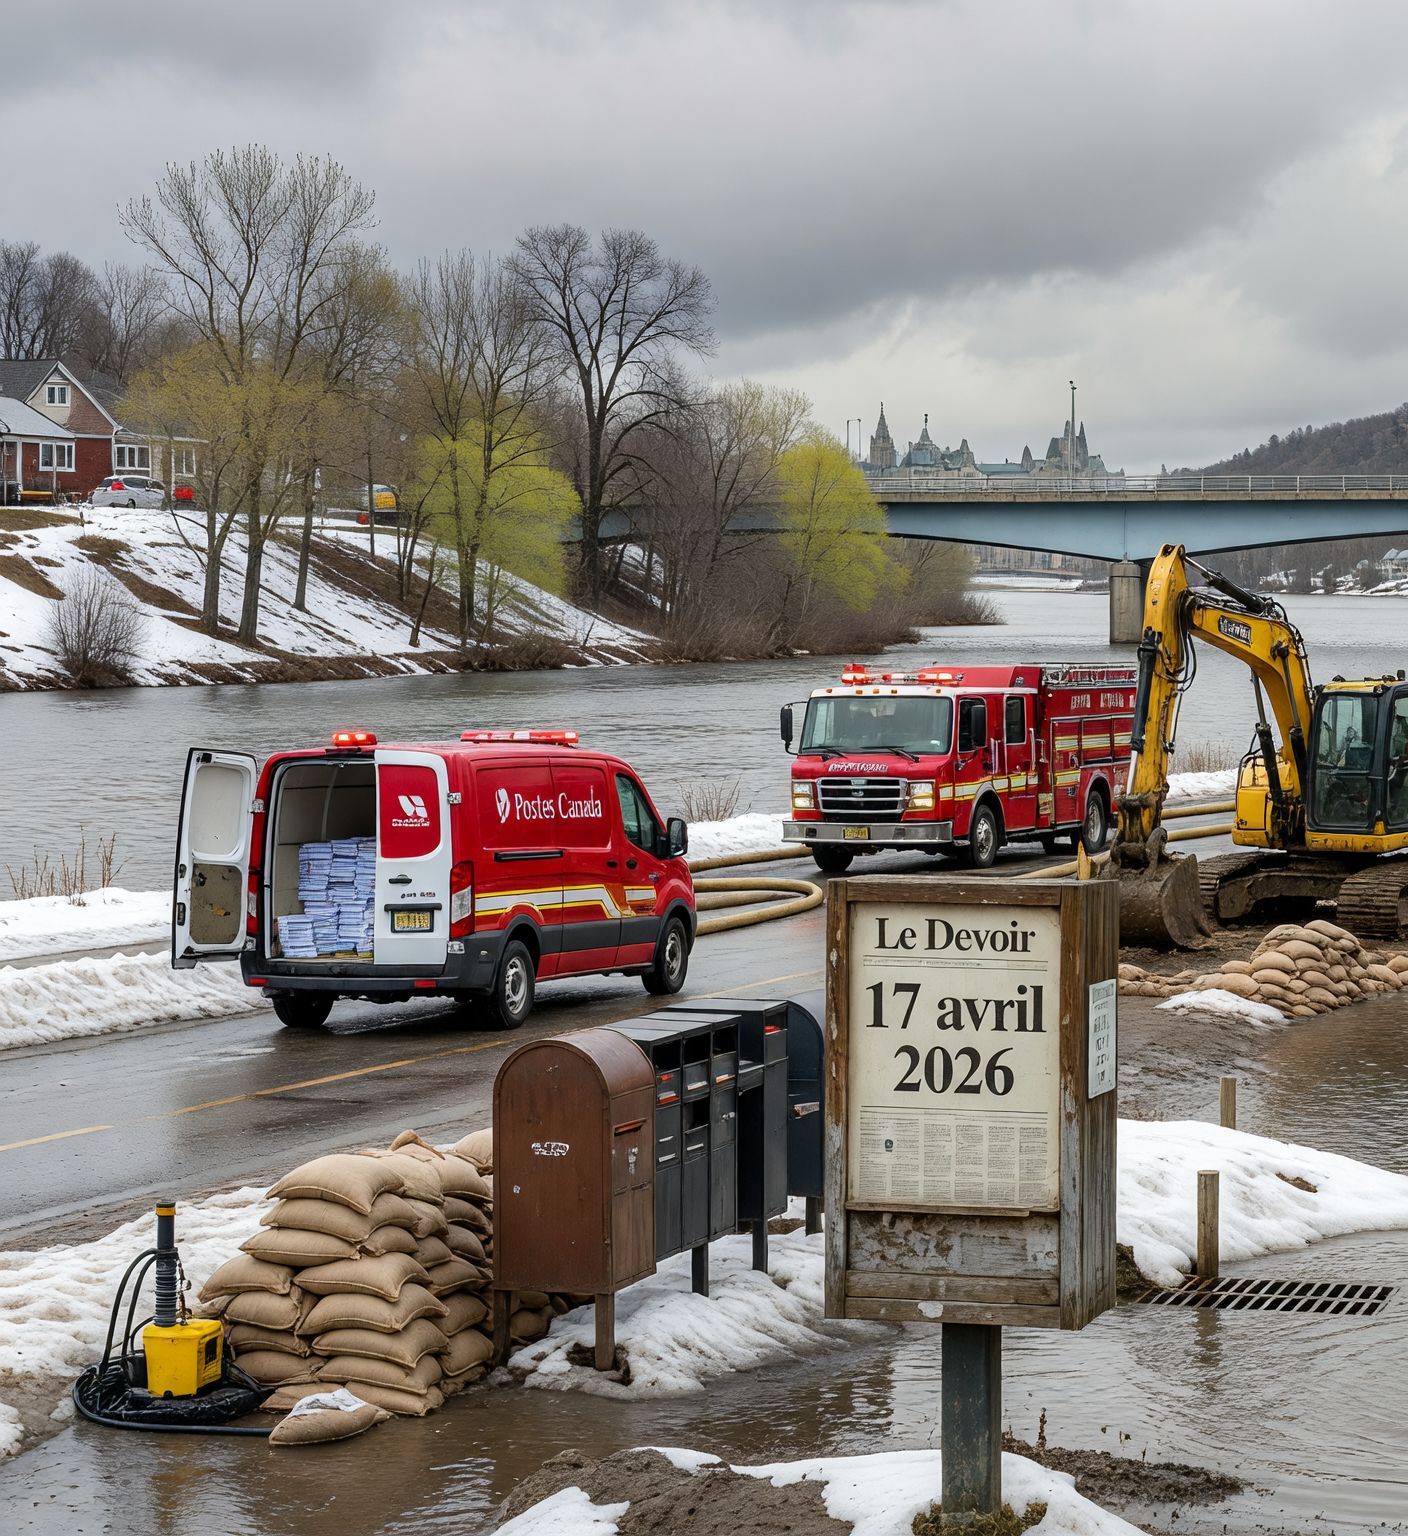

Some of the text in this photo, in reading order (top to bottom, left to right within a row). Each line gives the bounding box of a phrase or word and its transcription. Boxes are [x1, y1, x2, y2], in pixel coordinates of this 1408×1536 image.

[514, 785, 602, 820] Postes Canada
[875, 917, 1037, 953] Le Devoir
[865, 981, 1048, 1034] 17 avril
[893, 1044, 1015, 1096] 2026
